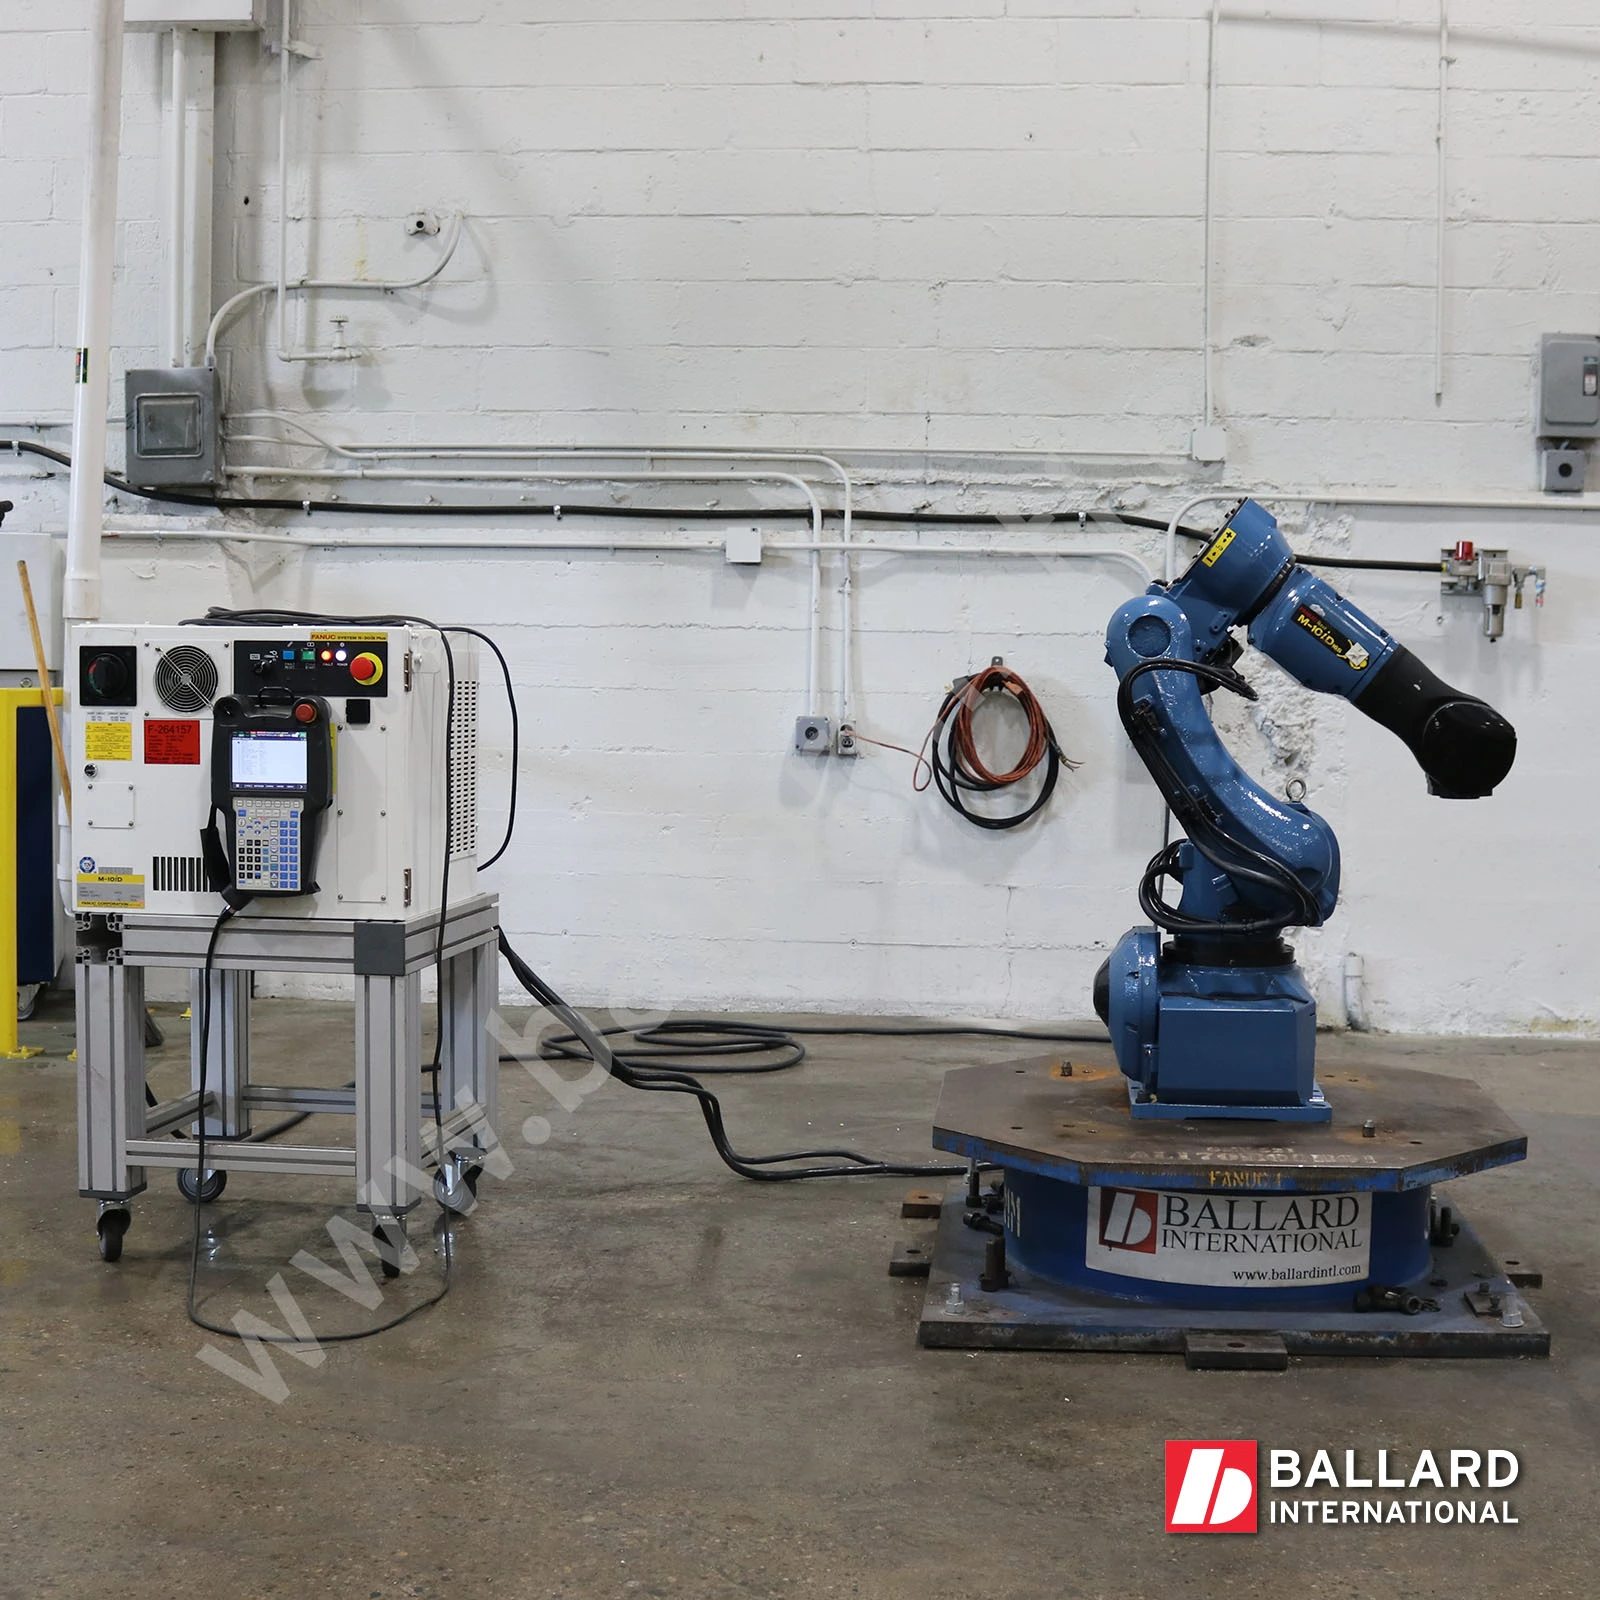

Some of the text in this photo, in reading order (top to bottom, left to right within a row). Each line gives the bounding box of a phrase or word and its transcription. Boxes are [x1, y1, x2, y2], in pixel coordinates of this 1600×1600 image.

[148, 724, 192, 735] F-264157
[1209, 1170, 1268, 1188] FANUC
[1162, 1194, 1360, 1231] BALLARD
[1161, 1229, 1362, 1253] INTERNATIONAL
[1232, 1263, 1362, 1281] www.ballardintl.com
